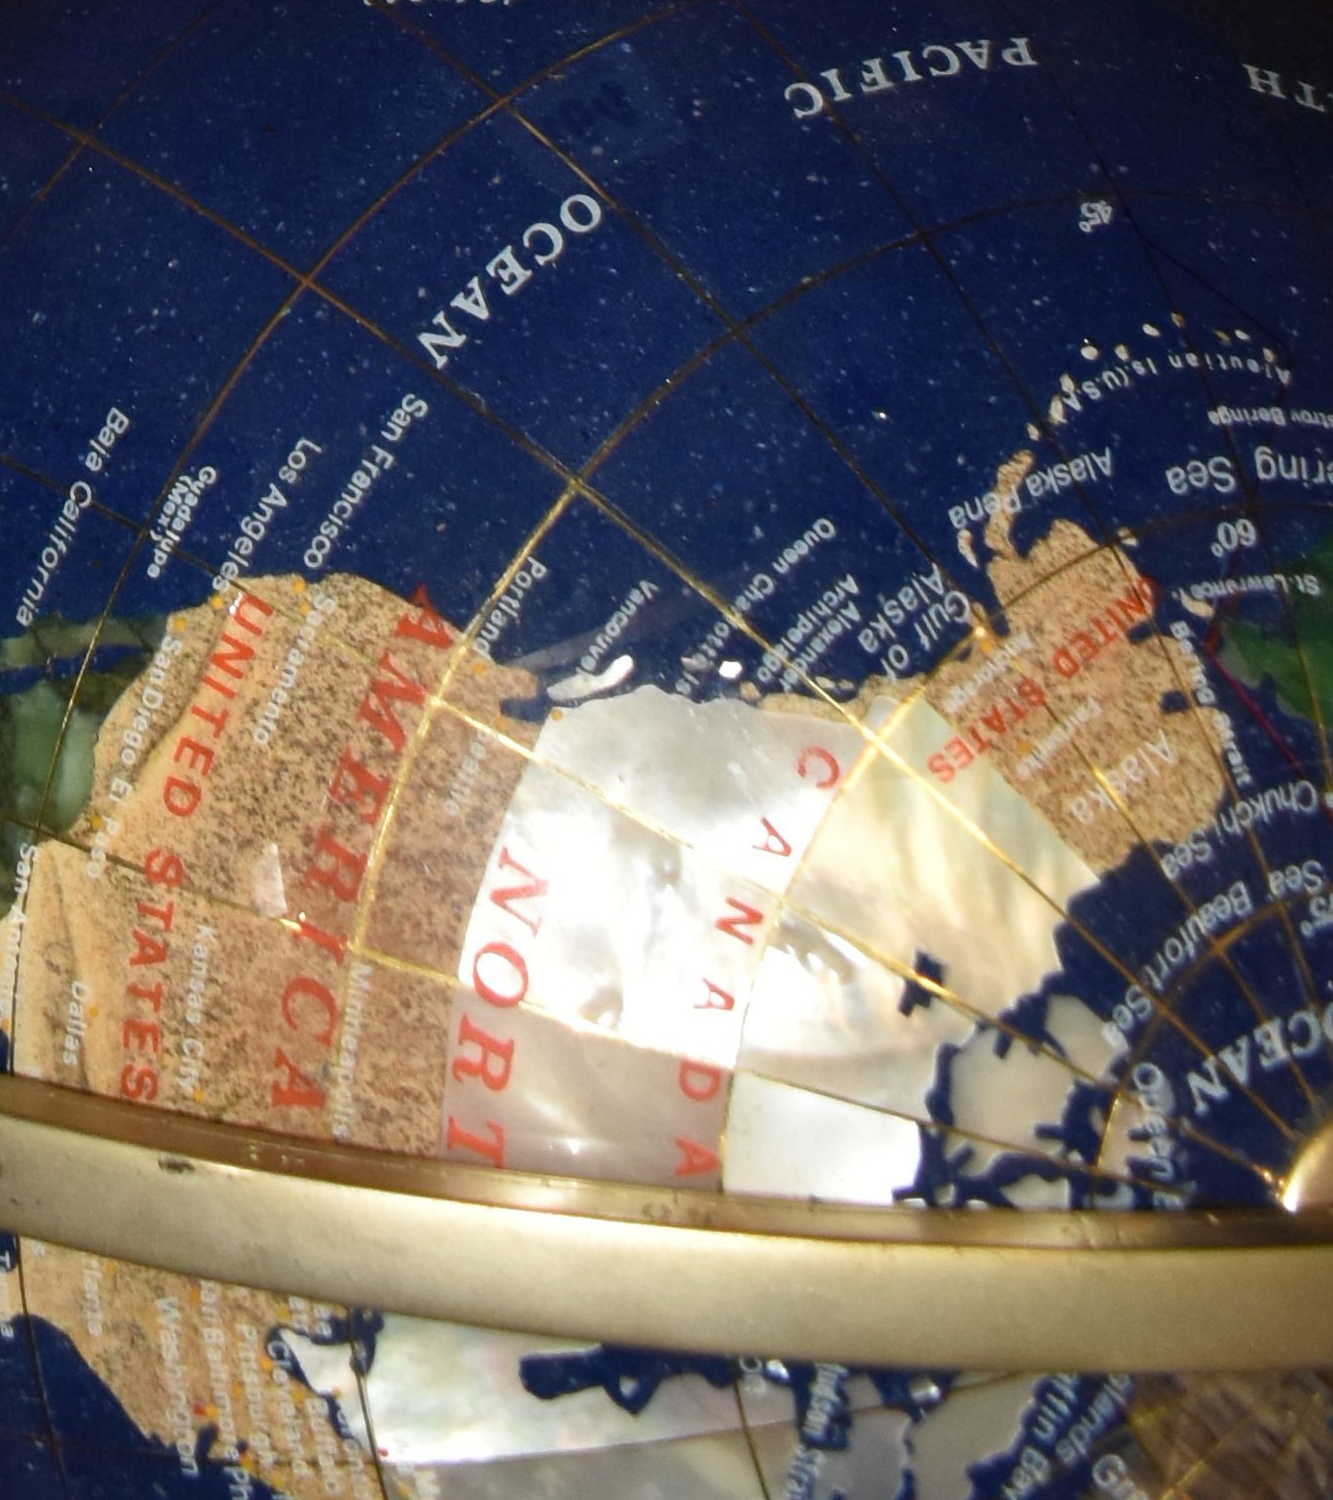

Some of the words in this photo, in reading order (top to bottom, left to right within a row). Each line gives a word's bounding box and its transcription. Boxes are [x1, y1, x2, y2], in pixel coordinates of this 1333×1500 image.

[783, 36, 1039, 119] PACIFIC
[417, 193, 602, 370] OCEAN
[84, 406, 129, 473] Baja
[278, 437, 324, 485] Los
[379, 392, 429, 443] San
[303, 442, 395, 570] Francisco
[948, 485, 1025, 530] Pena
[1024, 446, 1114, 498] Alaska
[1165, 455, 1236, 495] Sea
[16, 480, 93, 628] California
[211, 484, 290, 593] Angeles
[771, 517, 837, 577] Queen
[1210, 518, 1257, 559] 60°
[472, 556, 548, 660] Portland
[578, 578, 661, 678] Vancouver
[856, 562, 947, 655] Alaska
[914, 589, 972, 651] Gulf
[162, 591, 274, 818] UNITED
[1068, 728, 1179, 824] Alaska
[270, 583, 457, 1109] AMERICA
[120, 847, 183, 1101] STATES
[674, 745, 841, 1179] CANADA
[1152, 881, 1253, 992] Beaufort
[61, 978, 92, 1068] Dallas
[445, 840, 569, 1170] NORT
